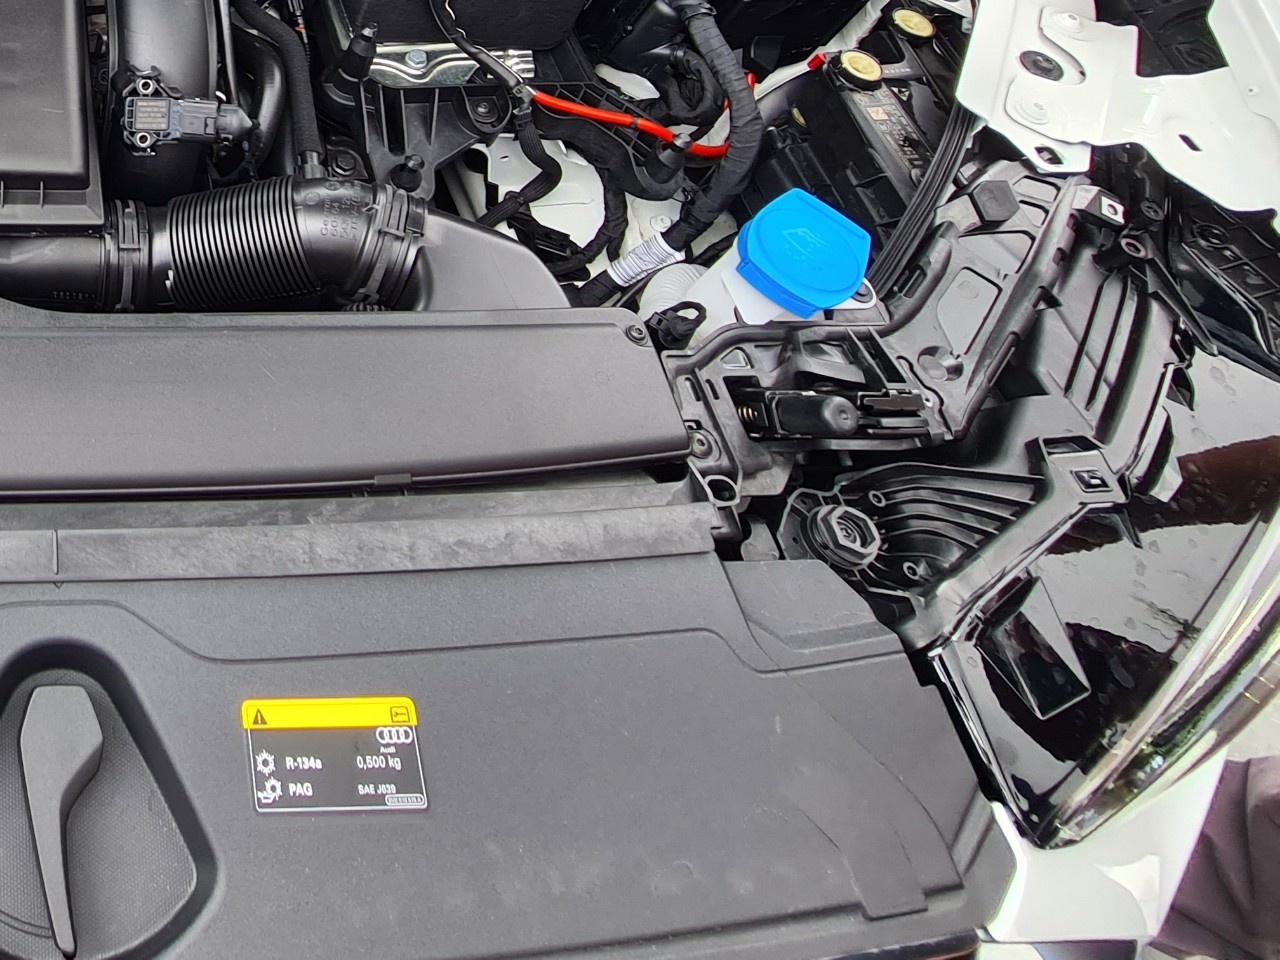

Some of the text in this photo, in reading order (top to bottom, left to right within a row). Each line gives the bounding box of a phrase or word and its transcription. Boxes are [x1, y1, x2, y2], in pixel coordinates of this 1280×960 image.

[286, 756, 322, 770] R-134a
[356, 756, 402, 771] 0,500 kg
[289, 783, 313, 796] PAG
[358, 784, 376, 795] SAE
